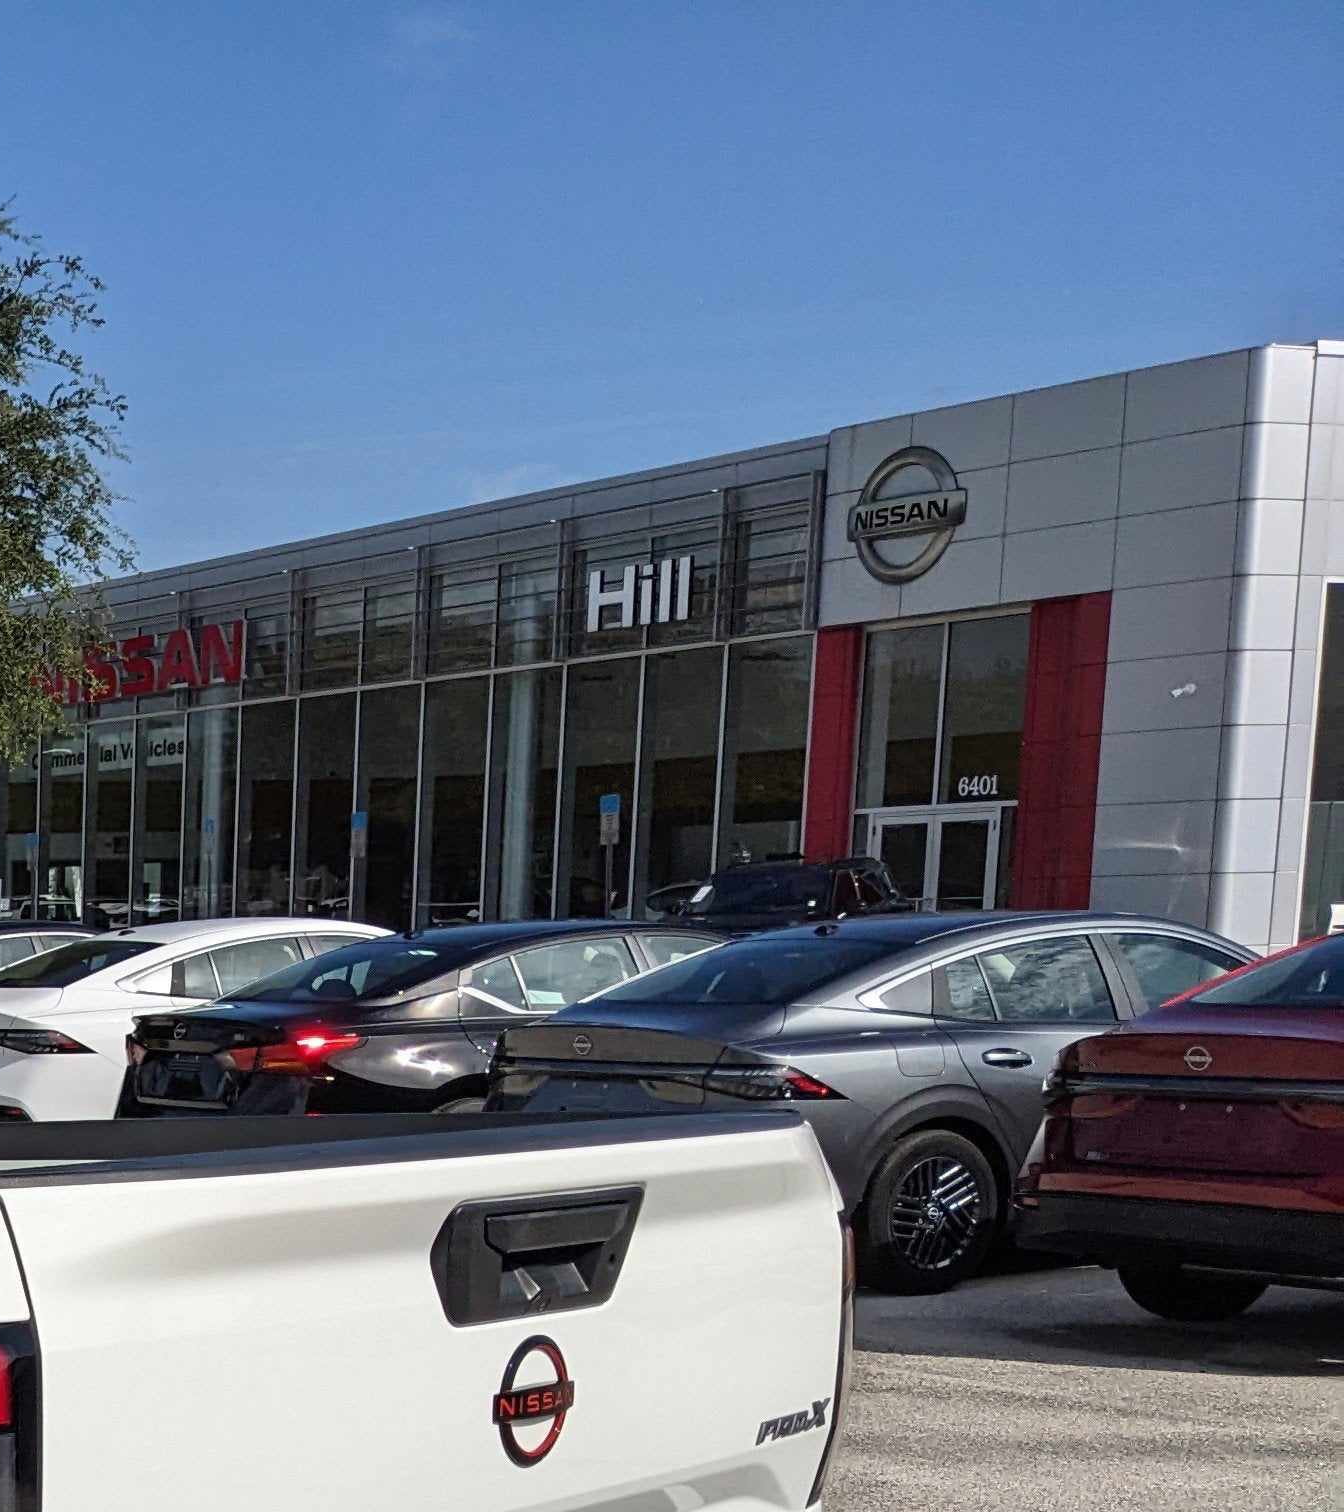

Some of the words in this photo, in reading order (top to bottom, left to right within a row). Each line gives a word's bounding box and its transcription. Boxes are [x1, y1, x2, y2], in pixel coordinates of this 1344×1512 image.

[854, 499, 948, 532] NISSAN
[587, 555, 694, 633] Hill
[958, 775, 998, 796] 6401
[498, 1386, 573, 1420] NISSAN
